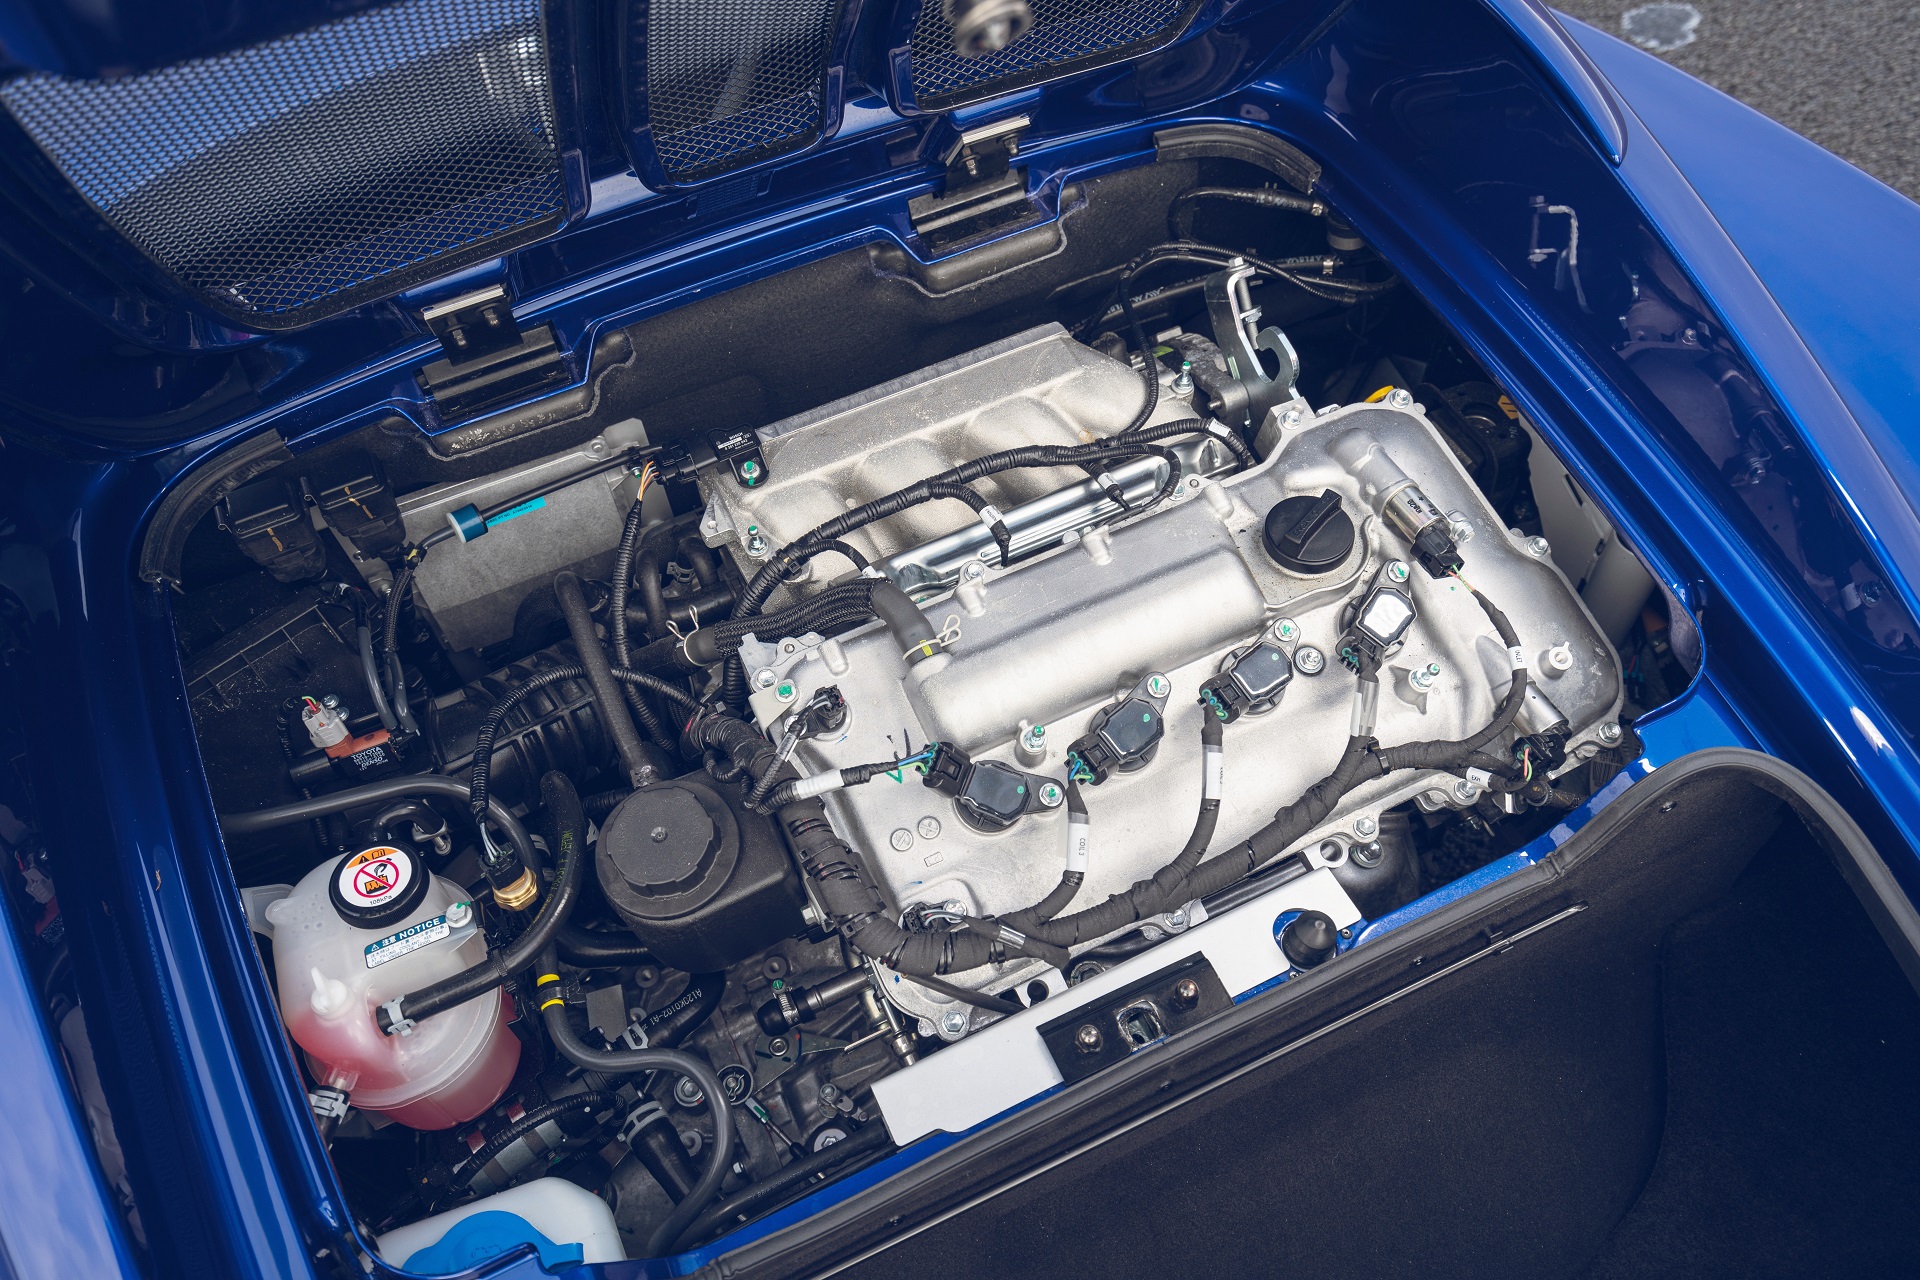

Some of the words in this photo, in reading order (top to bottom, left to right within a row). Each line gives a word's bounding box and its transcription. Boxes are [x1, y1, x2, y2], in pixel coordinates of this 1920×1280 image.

[351, 746, 382, 760] TOYOTA
[361, 757, 383, 769] DENSO
[370, 895, 392, 905] 108kPa
[400, 918, 440, 939] NOTICE
[382, 936, 396, 947] 注意
